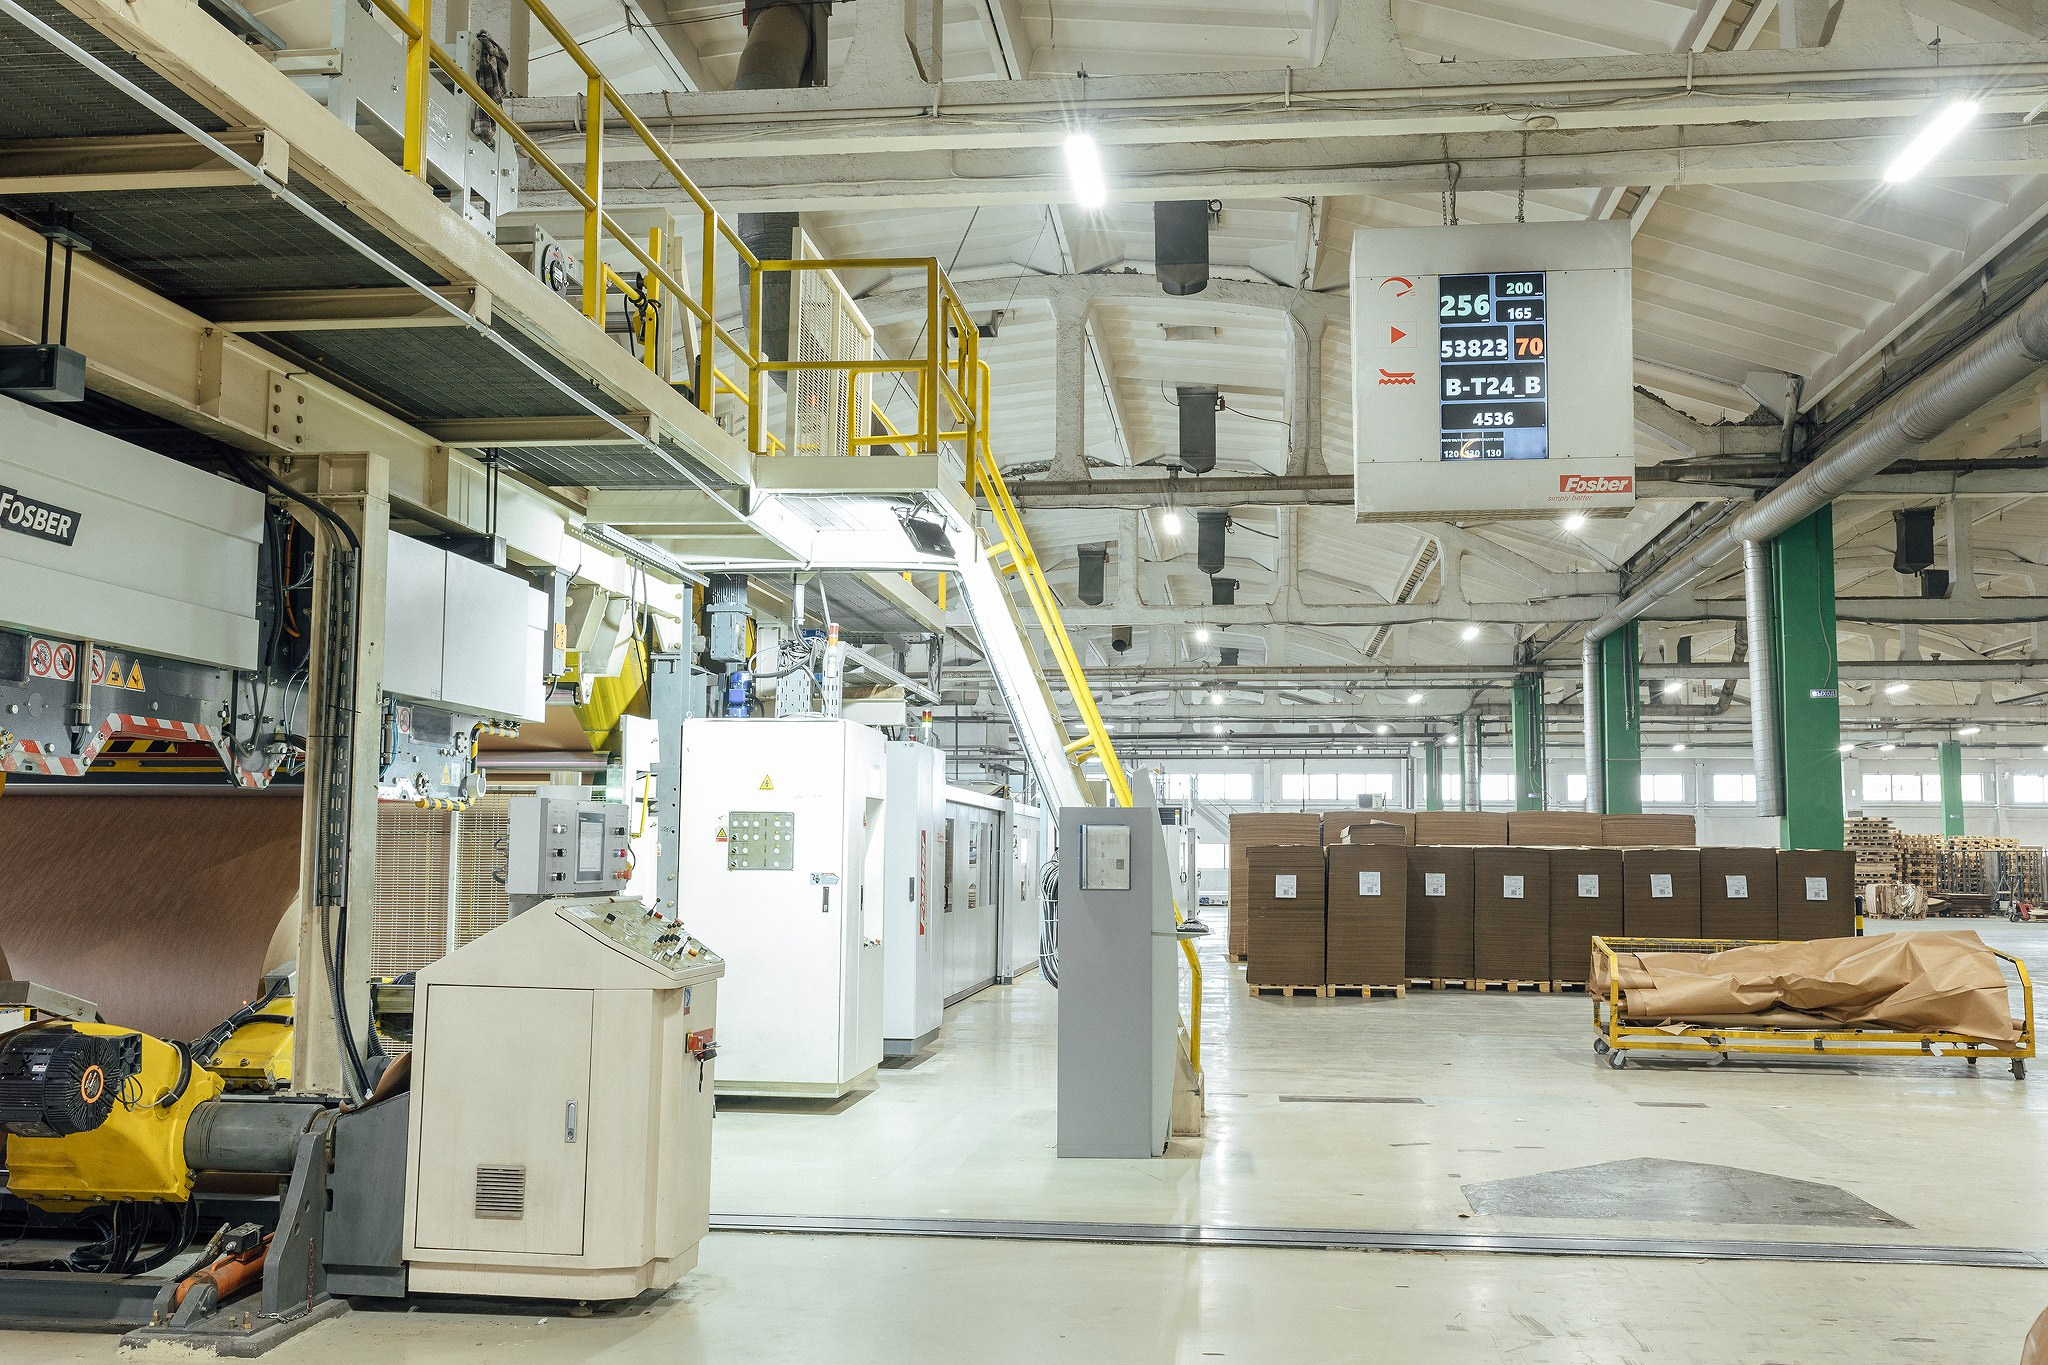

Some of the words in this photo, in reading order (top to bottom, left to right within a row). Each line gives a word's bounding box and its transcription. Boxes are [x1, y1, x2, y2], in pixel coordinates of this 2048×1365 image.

[1506, 281, 1533, 295] 200
[1440, 294, 1490, 317] 256
[1507, 307, 1532, 320] 165
[1441, 338, 1508, 358] 53823
[1515, 337, 1544, 356] 70
[1472, 411, 1514, 427] 4536
[1443, 449, 1459, 458] 120
[1486, 448, 1502, 458] 130
[1564, 477, 1629, 492] Fosber
[1547, 494, 1570, 503] simply
[1571, 494, 1593, 502] better
[0, 492, 72, 538] FOSBER
